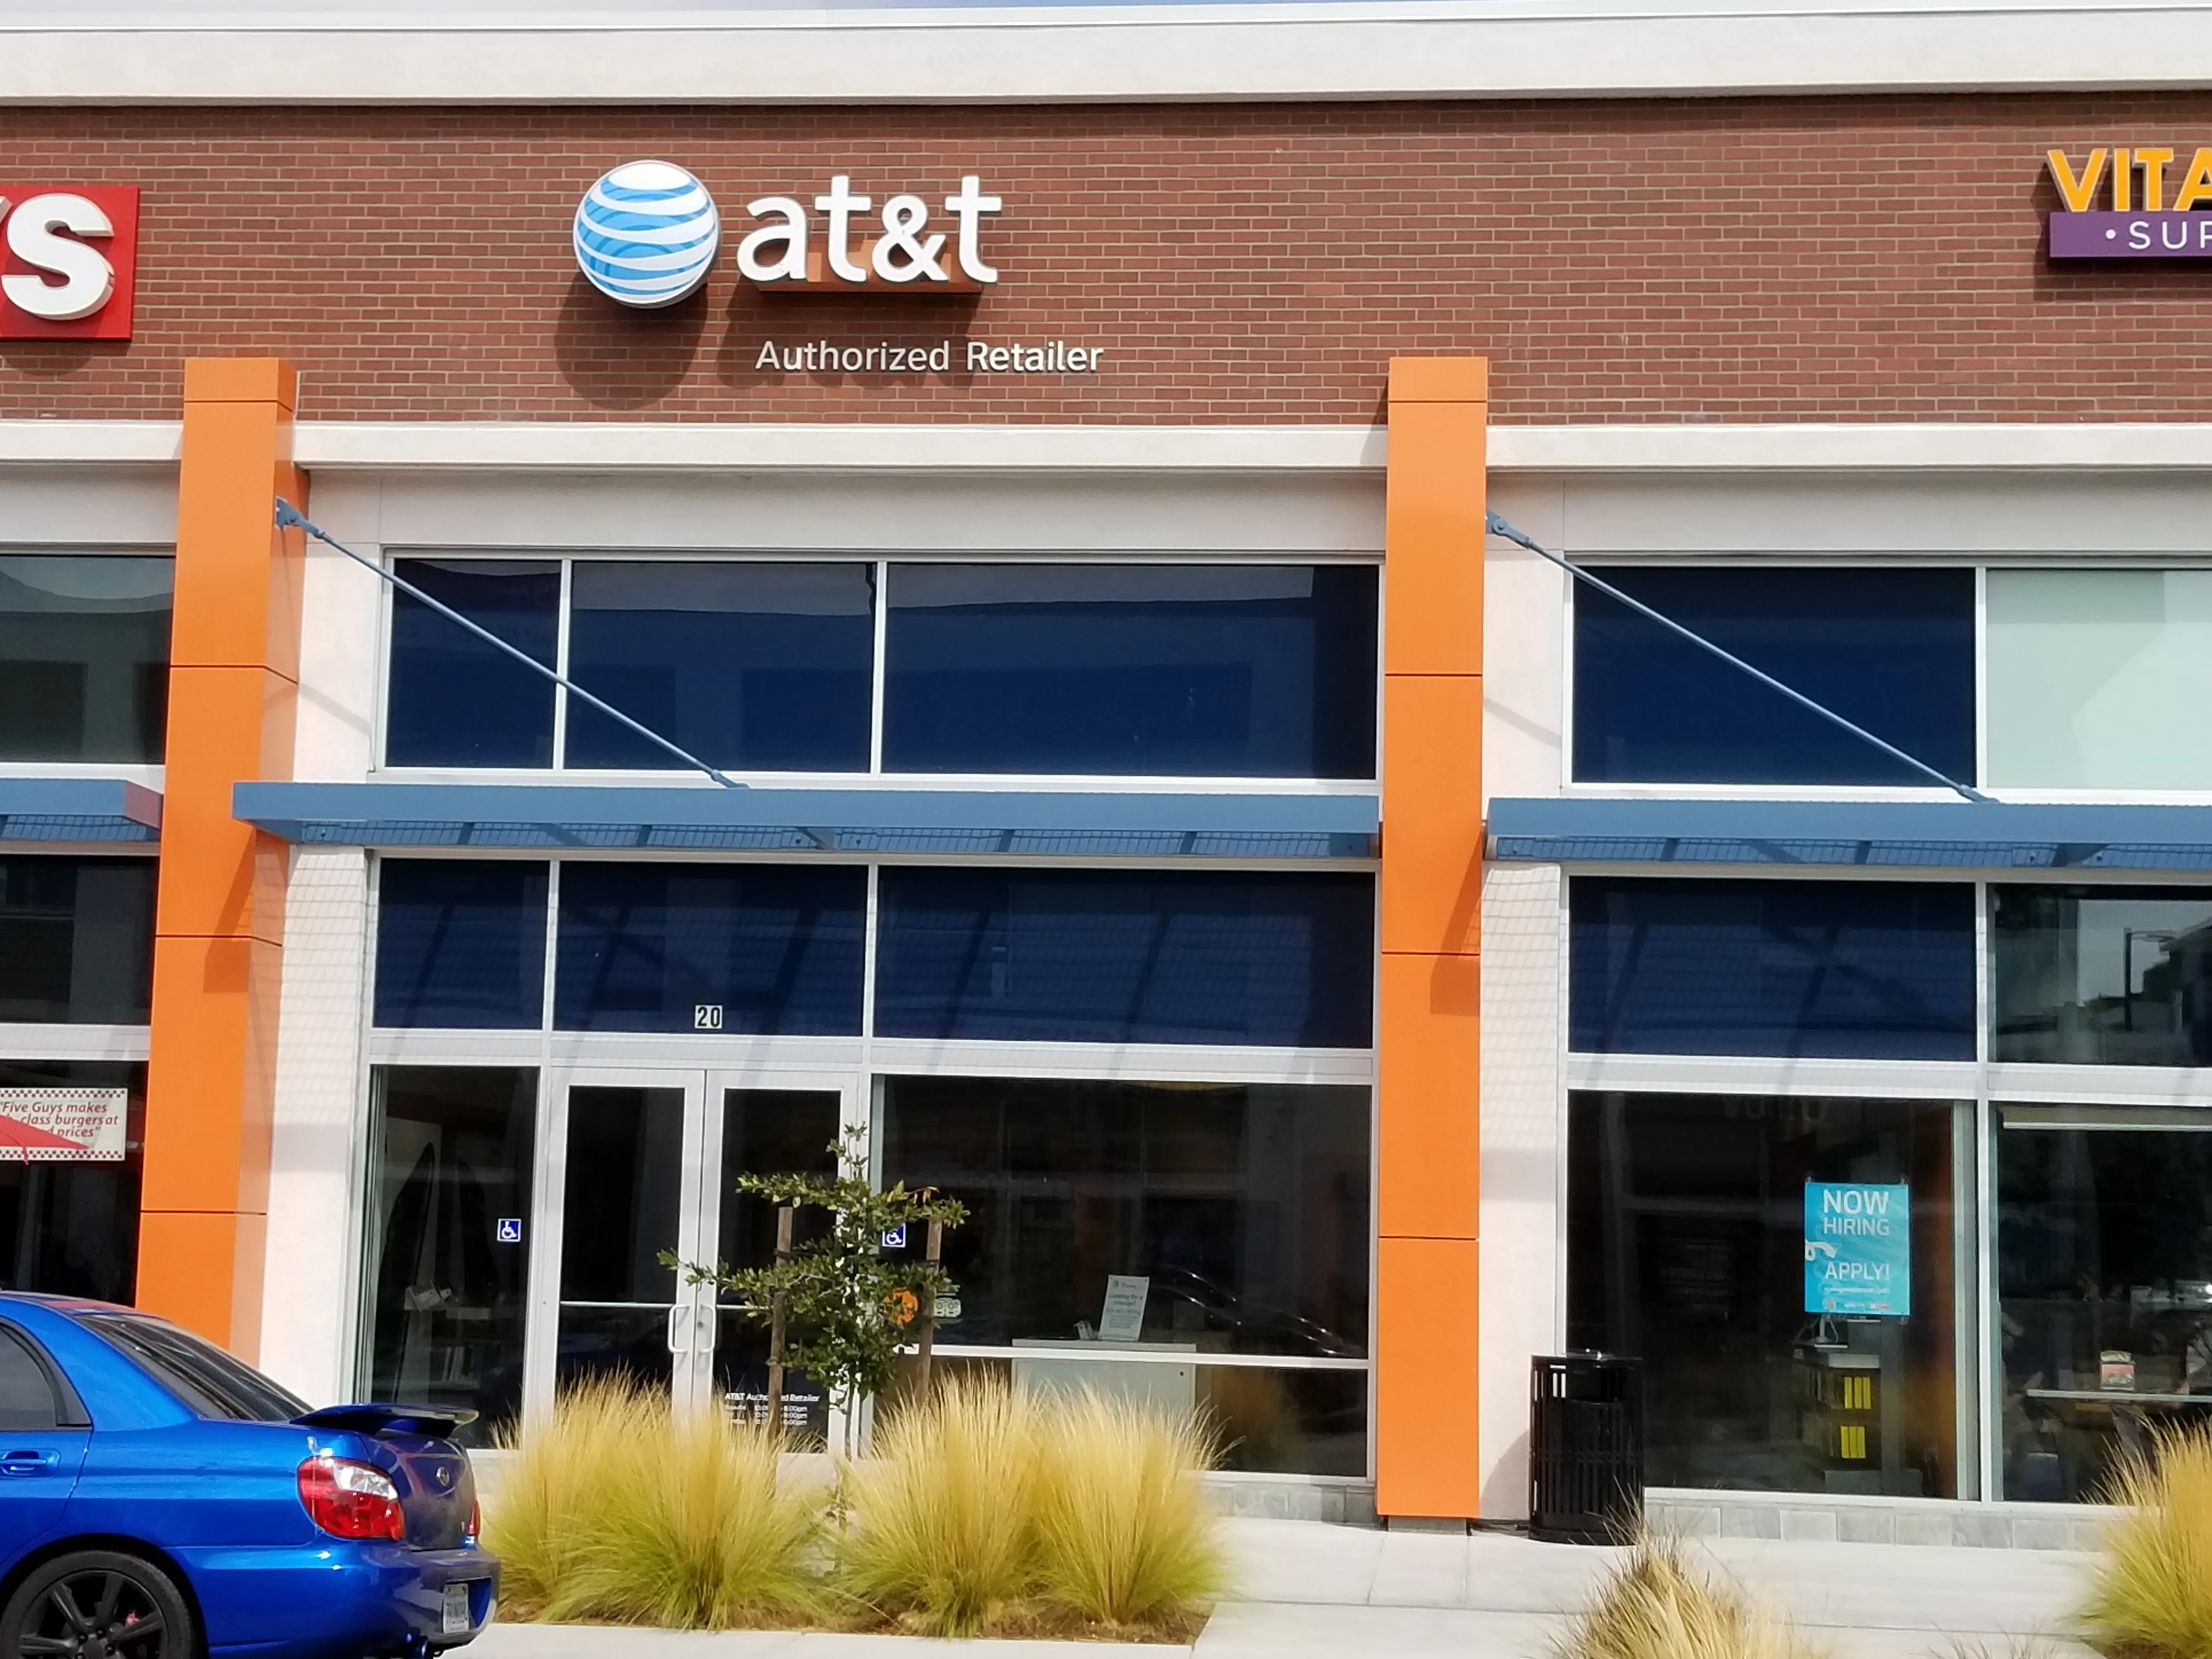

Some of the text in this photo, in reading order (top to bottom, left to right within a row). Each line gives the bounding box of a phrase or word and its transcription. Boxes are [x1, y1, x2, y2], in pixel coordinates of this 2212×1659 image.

[755, 340, 1104, 373] Authorized Retailer
[697, 1006, 720, 1028] 20
[32, 1101, 63, 1115] Guys
[66, 1101, 108, 1113] makes
[55, 1113, 104, 1127] burgers
[105, 1115, 119, 1125] at
[1823, 1189, 1889, 1215] NOW
[1823, 1217, 1890, 1236] HIRING
[1825, 1262, 1890, 1280] APPLY!
